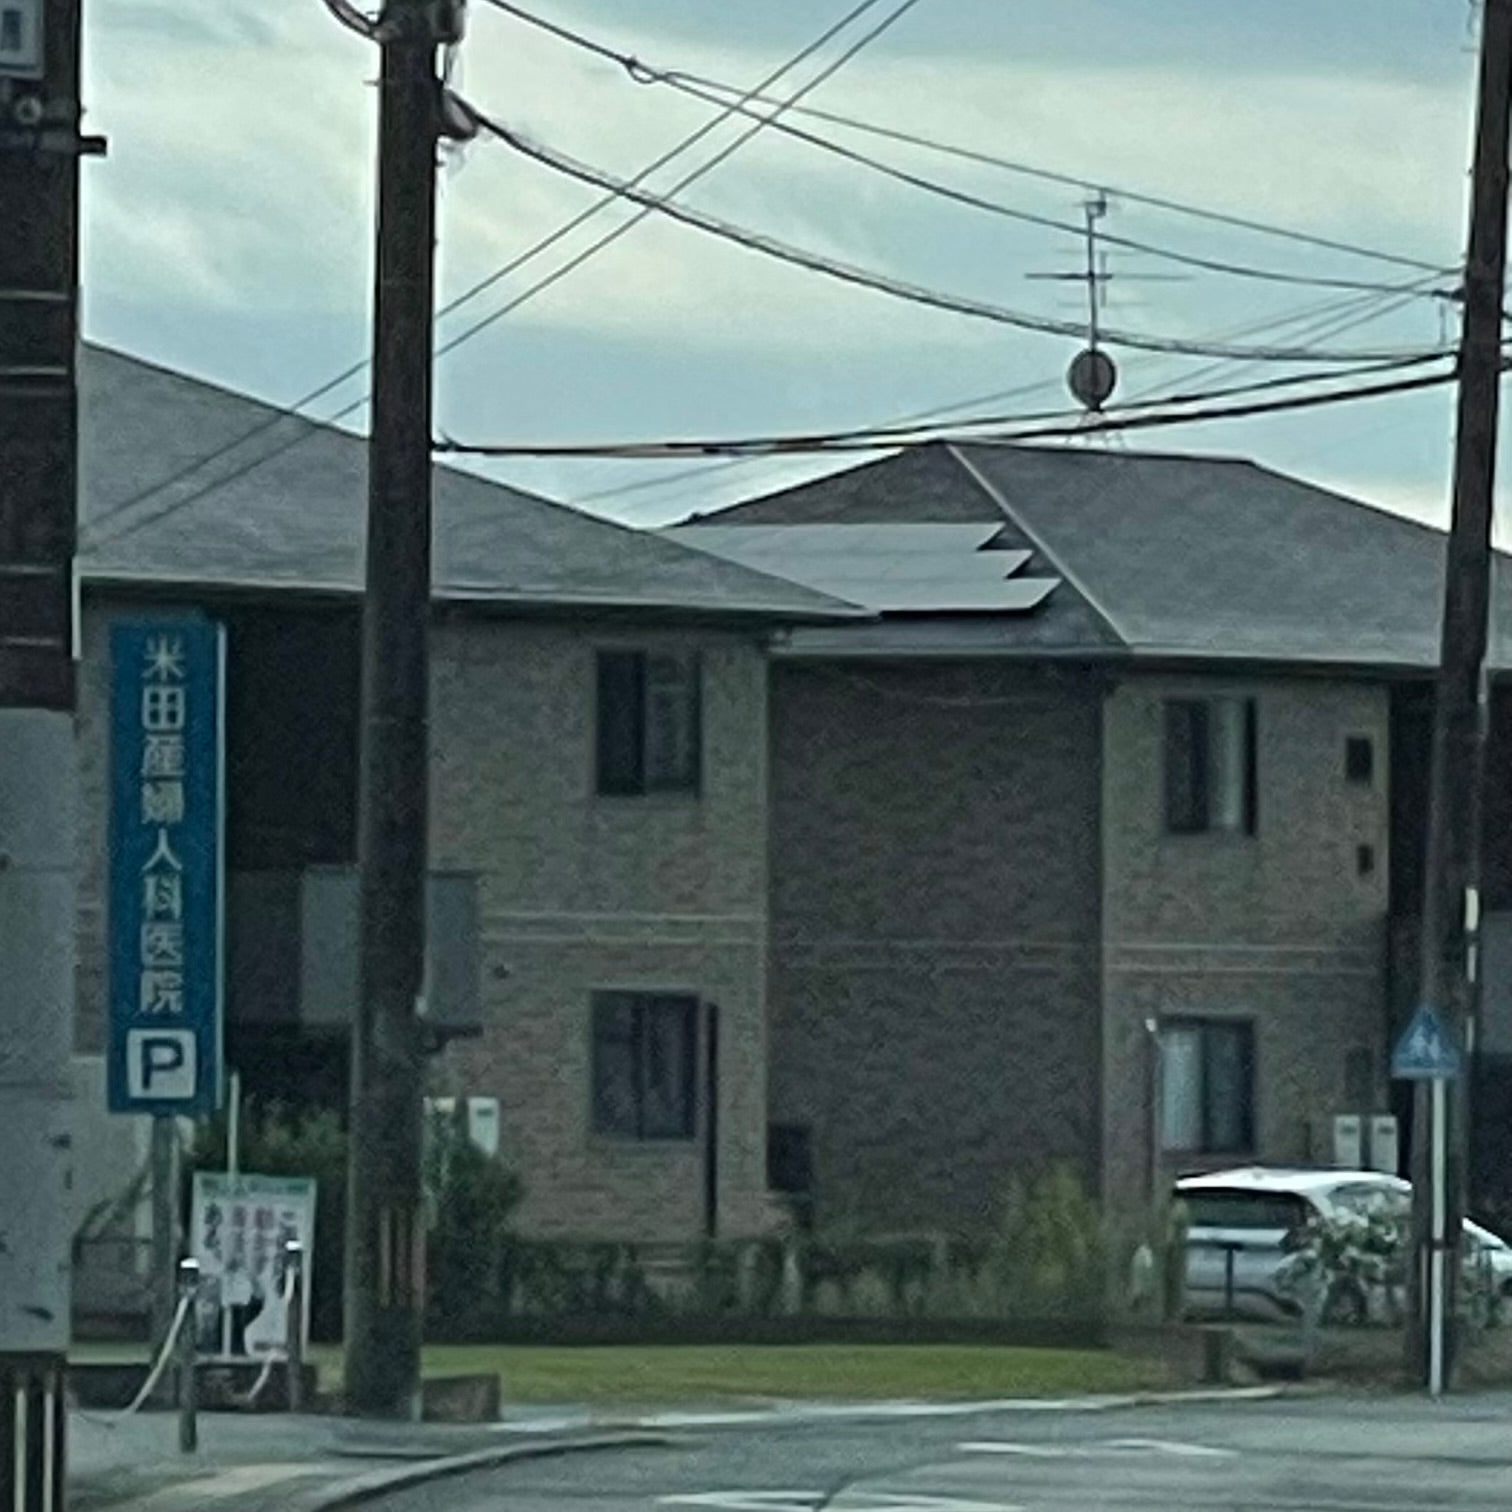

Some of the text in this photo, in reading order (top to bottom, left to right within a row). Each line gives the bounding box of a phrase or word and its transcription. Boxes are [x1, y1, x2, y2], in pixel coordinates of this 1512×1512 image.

[141, 634, 185, 1013] 米田産婦人科医院
[141, 1038, 183, 1090] P
